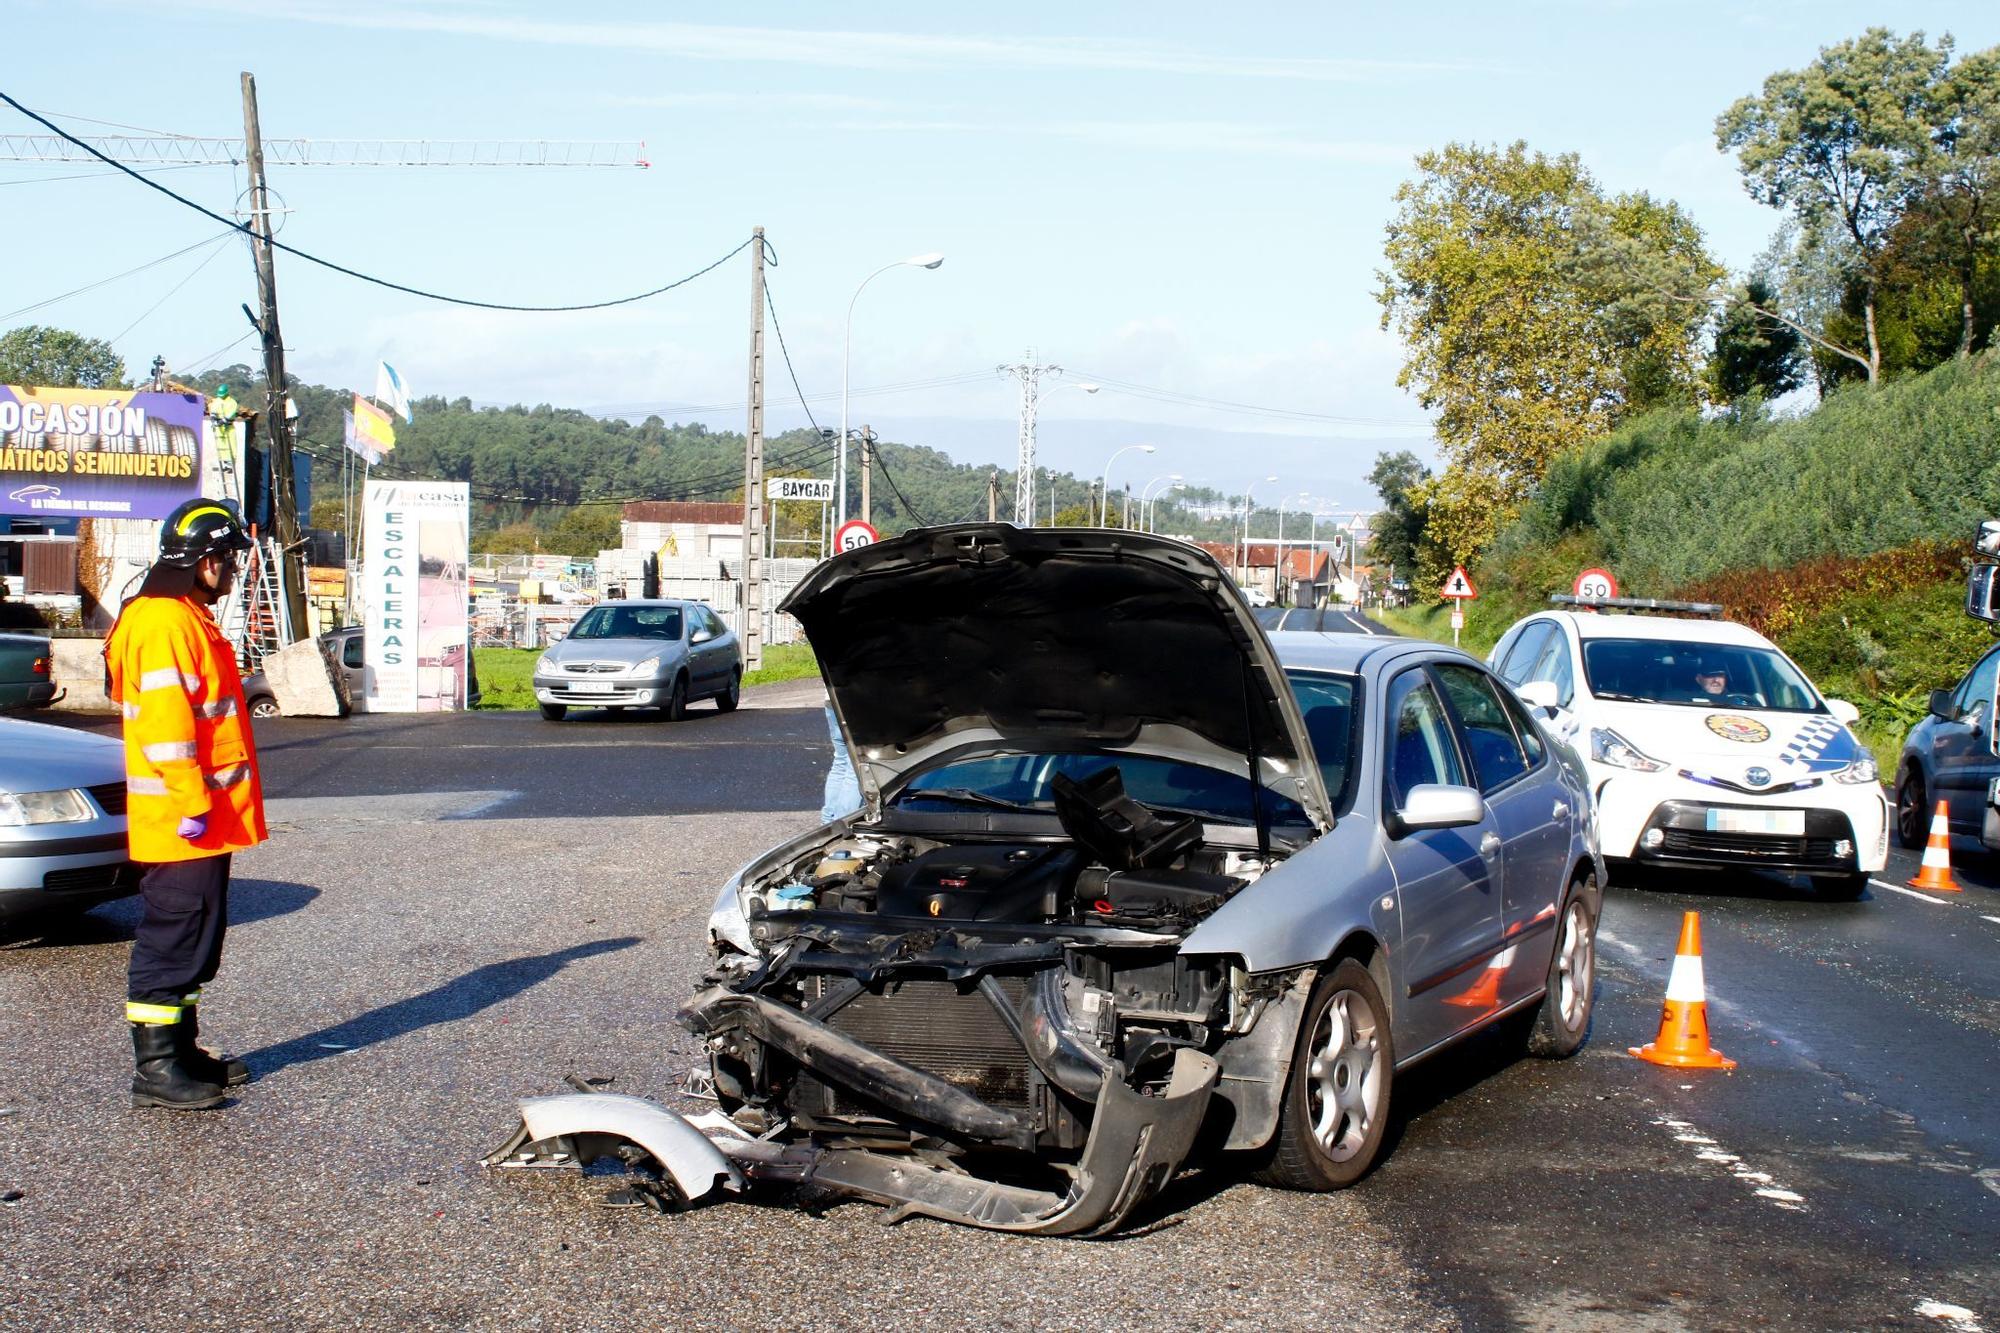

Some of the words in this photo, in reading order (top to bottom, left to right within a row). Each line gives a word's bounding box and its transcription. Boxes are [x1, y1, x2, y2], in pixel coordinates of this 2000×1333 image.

[0, 400, 145, 437] OCASIÓN
[0, 443, 69, 474] ÁTICOS
[74, 451, 192, 478] SEMINUEVOS
[782, 482, 830, 498] BAYGAR
[845, 535, 869, 551] 50
[382, 512, 403, 665] ESCALERAS
[1584, 583, 1607, 597] 50
